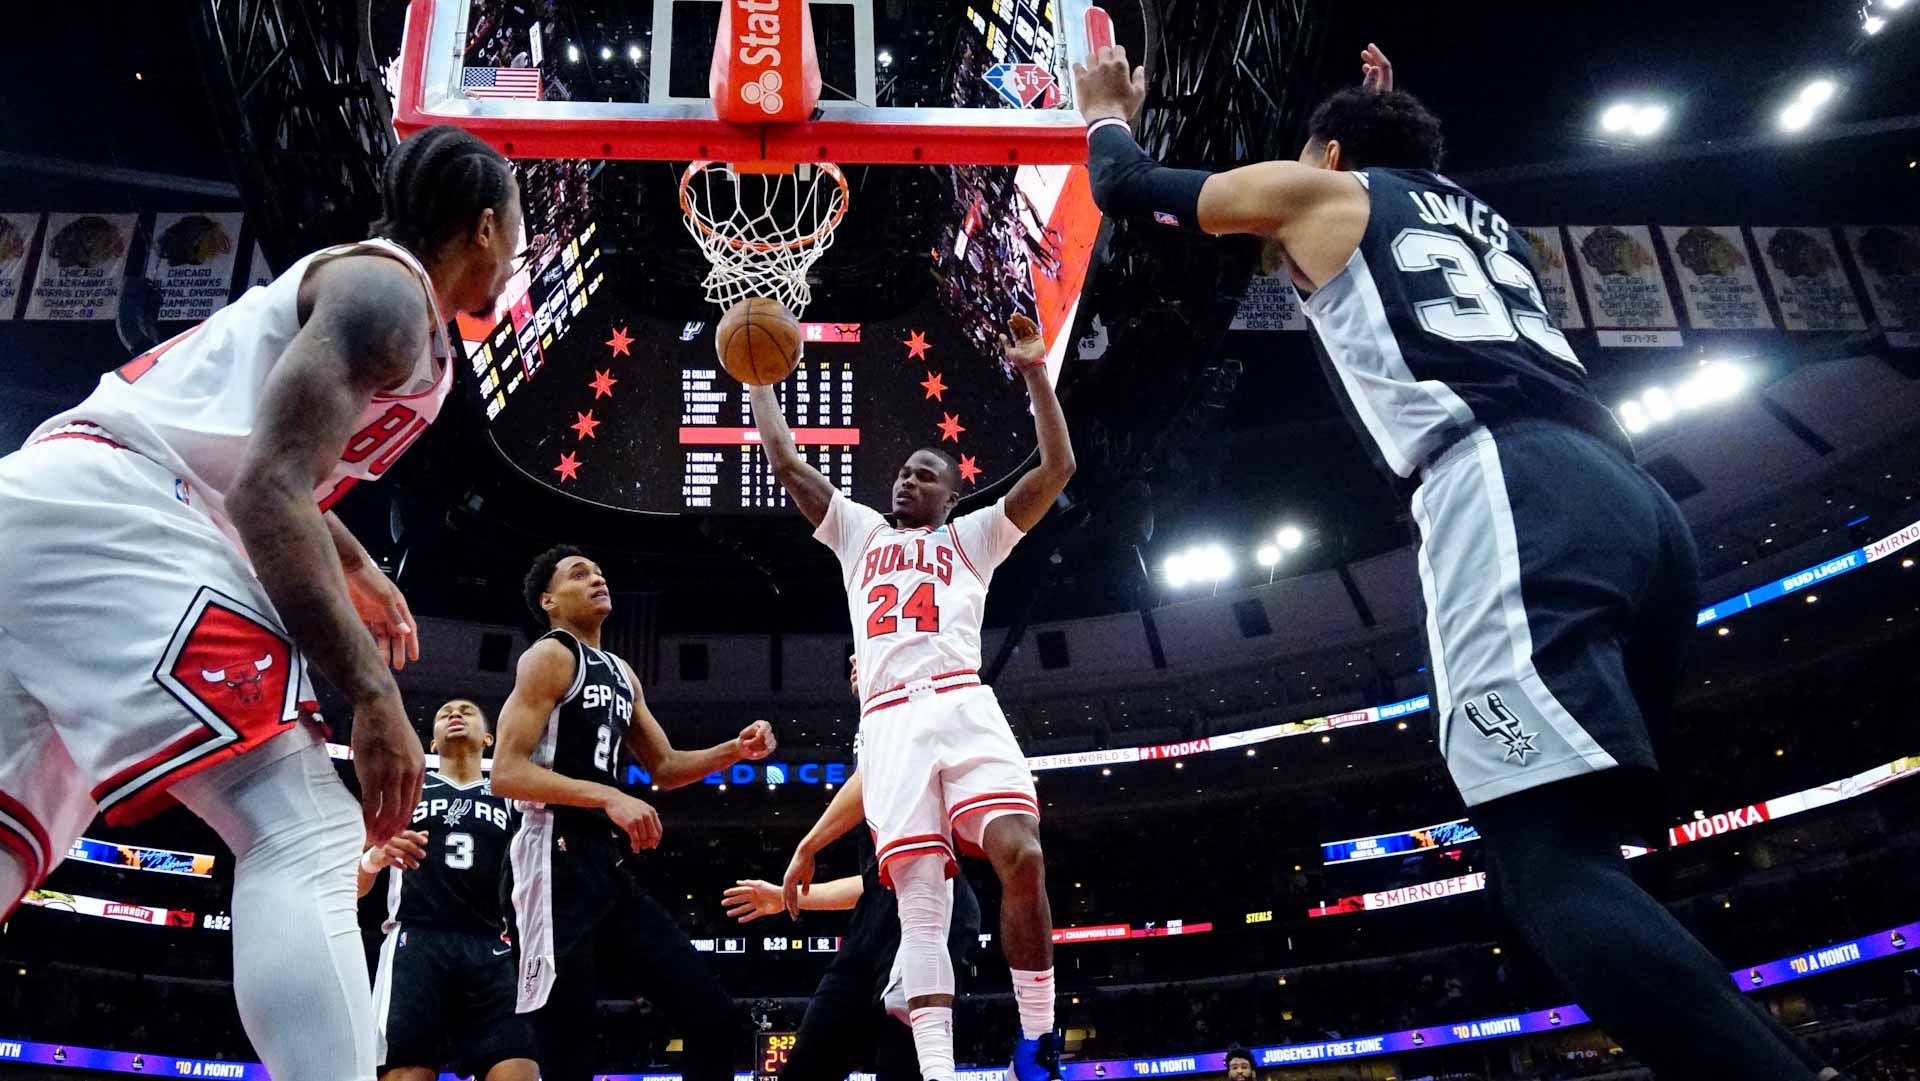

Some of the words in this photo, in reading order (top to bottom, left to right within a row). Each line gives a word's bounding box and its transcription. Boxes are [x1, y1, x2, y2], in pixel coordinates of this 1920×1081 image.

[739, 0, 782, 67] Stat
[1024, 71, 1038, 85] 75
[1407, 190, 1510, 251] JONES
[59, 268, 104, 278] CHICAGO
[168, 269, 212, 278] CHICAGO
[43, 278, 113, 288] BLACKHAWKS
[159, 278, 222, 288] LACKHAWKS
[34, 287, 72, 297] NORRIS
[75, 288, 118, 298] DIVISION
[189, 288, 229, 297] DIVISION
[1246, 295, 1286, 303] ESTERN
[44, 298, 104, 308] CHAMPIONS
[159, 298, 213, 308] HAMPIONS
[159, 308, 211, 318] 009-2010
[1235, 311, 1292, 320] CHAMPIONS
[1246, 320, 1283, 329] 2012-13
[1622, 334, 1658, 343] 1971-72
[1783, 572, 1814, 591] BUD
[1813, 554, 1856, 580] LIGHT
[1864, 524, 1920, 560] SMIRNO
[861, 539, 953, 591] BULLS
[866, 582, 940, 640] 24
[1038, 758, 1048, 767] IS
[1052, 754, 1074, 766] THE
[1078, 750, 1131, 764] WORLD'S
[1140, 746, 1158, 759] #1
[1161, 740, 1210, 758] VODKA
[1380, 703, 1406, 718] BUD
[1681, 805, 1764, 842] VODKA
[444, 832, 475, 870] 3
[1374, 876, 1468, 908] SMIRNOFF
[106, 904, 150, 919] SMIRNOFF
[1245, 910, 1272, 924] STEALS
[203, 914, 231, 931] 8:52
[1065, 929, 1107, 939] CHAMPIONS
[1107, 927, 1126, 937] CLUB
[763, 937, 787, 951] 9:23
[1790, 957, 1808, 974] $10
[1809, 954, 1819, 970] A
[1817, 943, 1860, 968] MONTH
[1453, 1025, 1470, 1039] $10
[1471, 1023, 1480, 1037] A
[1480, 1017, 1521, 1036] MONTH
[1134, 1061, 1149, 1074] $10
[1151, 1061, 1159, 1073] A
[1160, 1058, 1195, 1073] MONTH
[1263, 1045, 1325, 1063] JUDGEMENT
[1326, 1042, 1355, 1057] FREE
[176, 1061, 192, 1075] $10
[192, 1063, 201, 1075] A
[203, 1063, 244, 1078] MONTH
